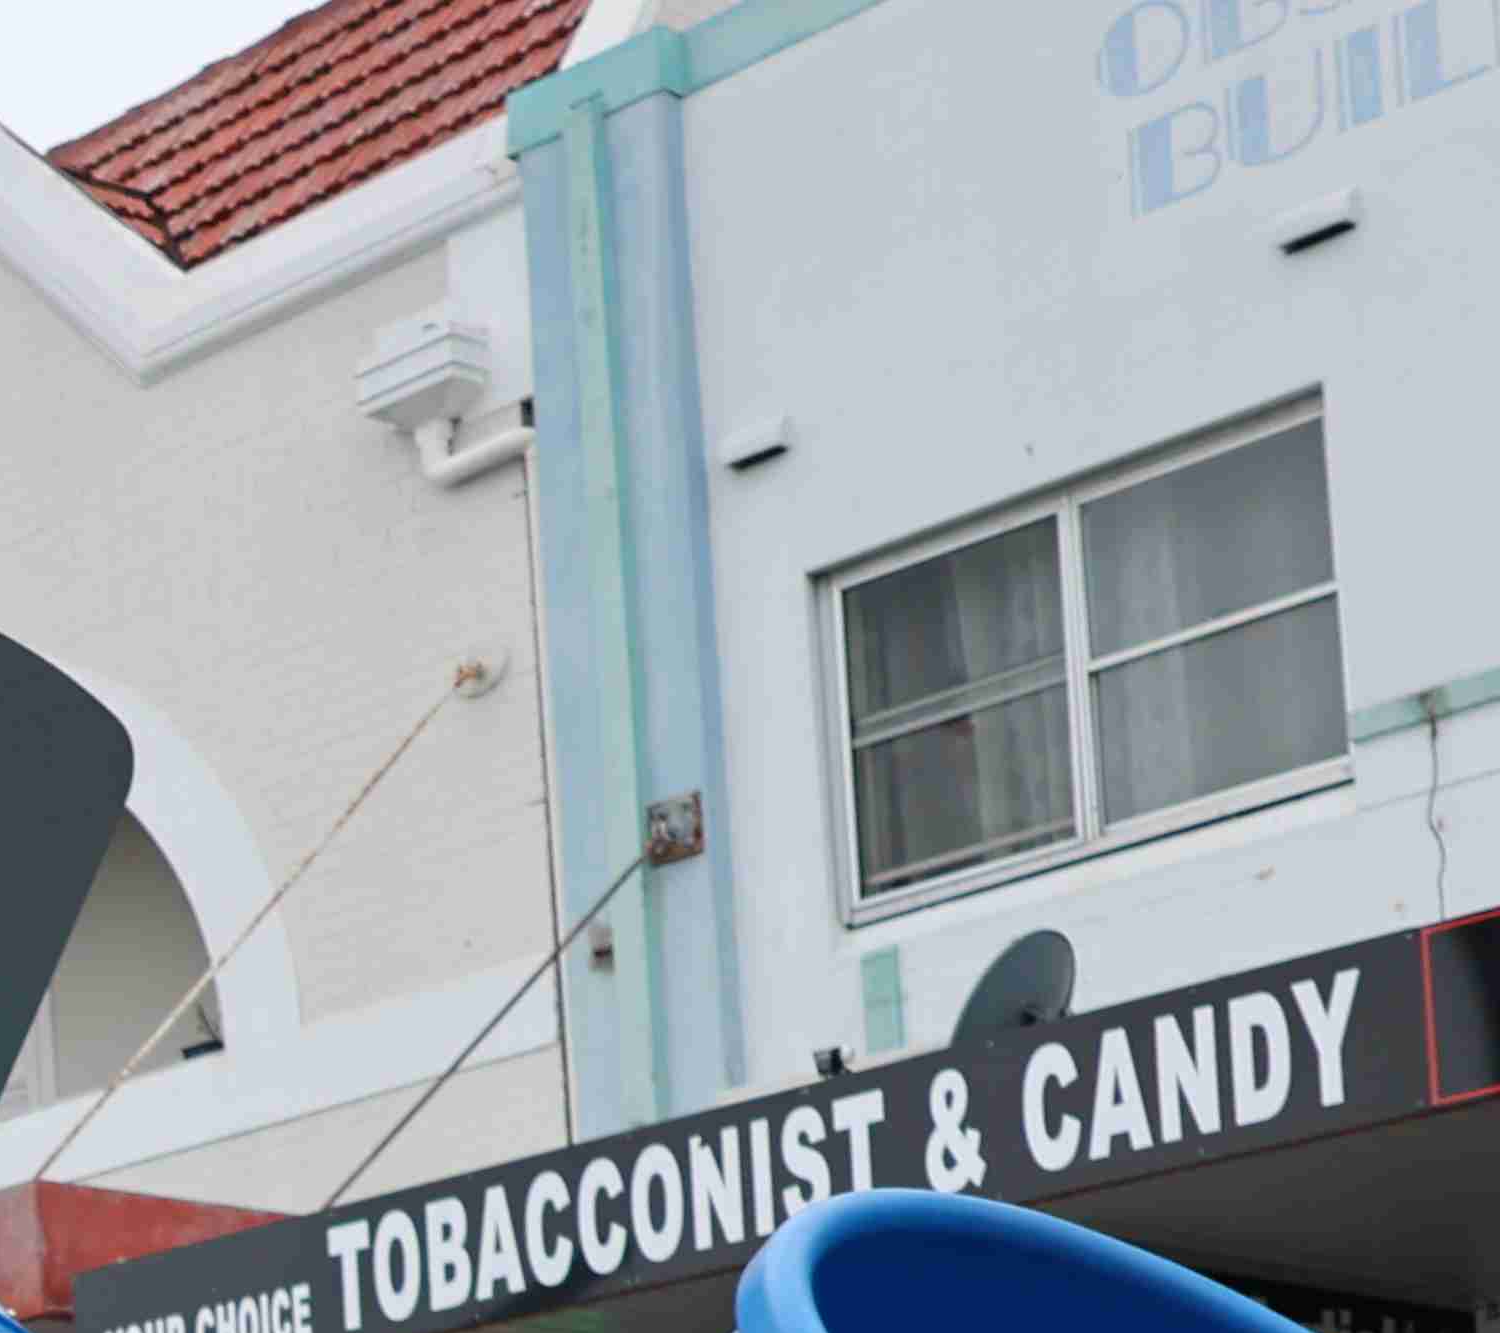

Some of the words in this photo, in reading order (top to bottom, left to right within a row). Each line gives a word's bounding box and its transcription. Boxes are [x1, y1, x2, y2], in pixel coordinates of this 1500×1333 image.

[326, 1089, 885, 1331] TOBACCONIST
[925, 1069, 988, 1193] &
[1022, 967, 1360, 1172] CANDY
